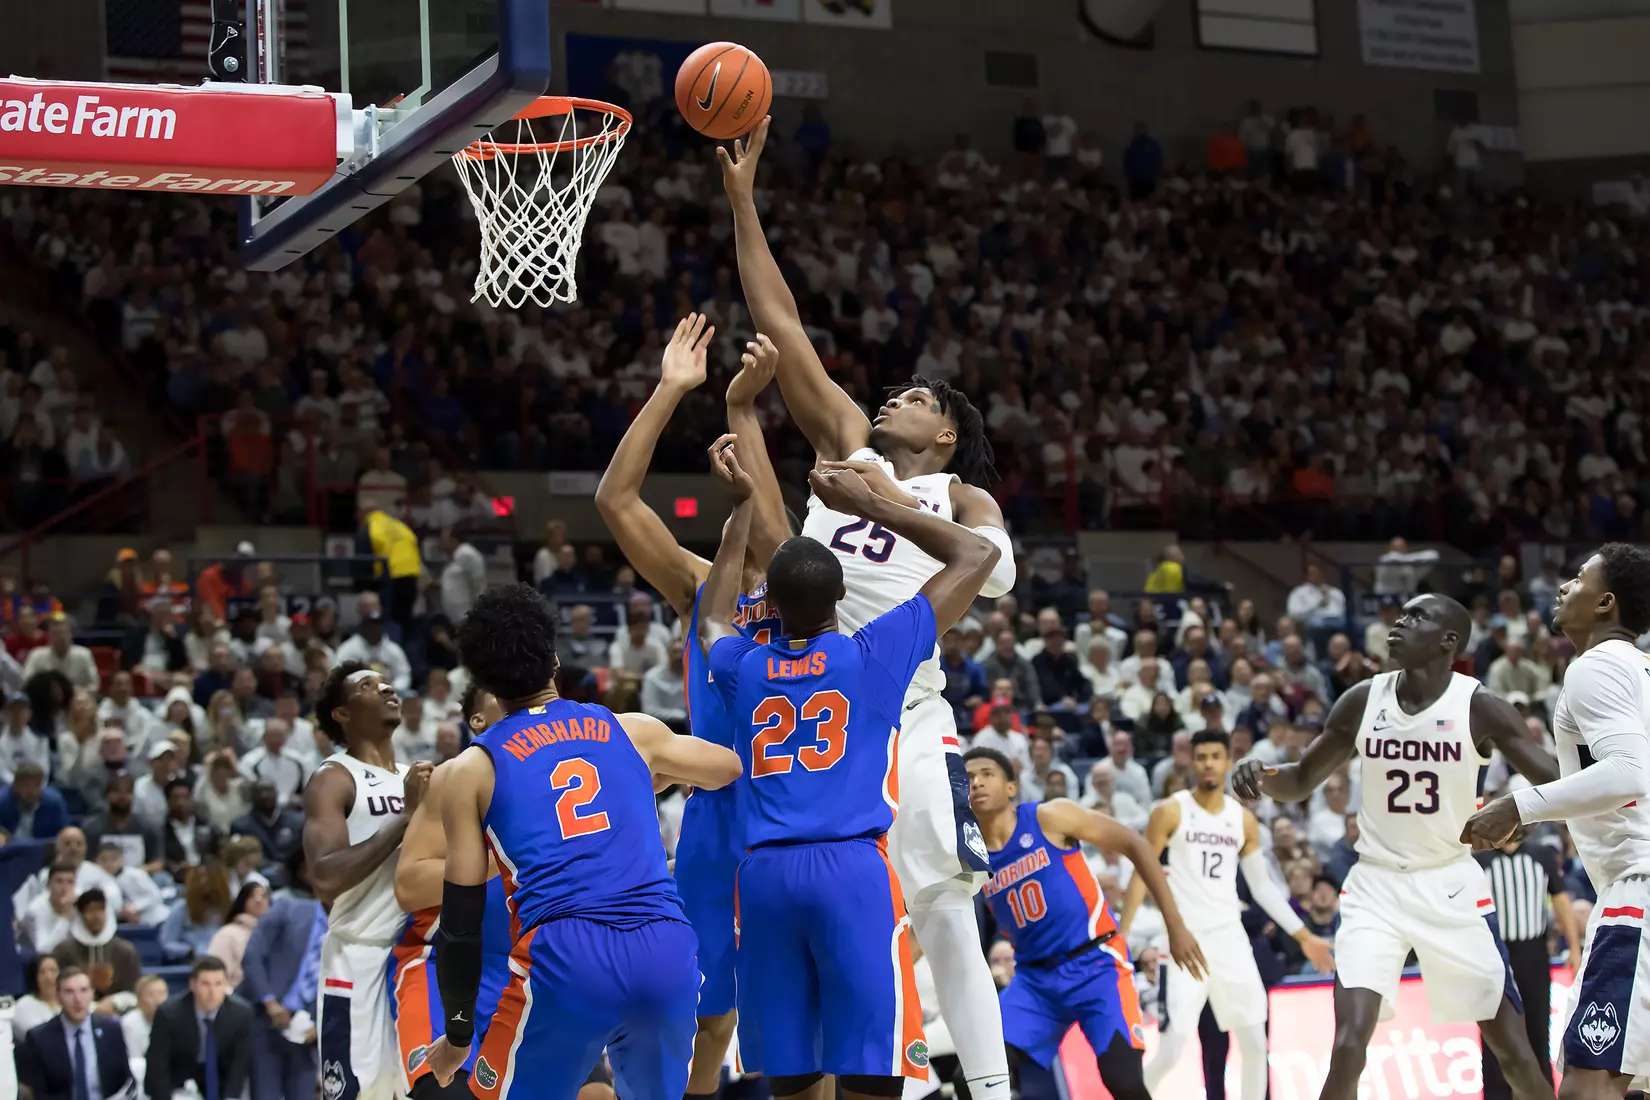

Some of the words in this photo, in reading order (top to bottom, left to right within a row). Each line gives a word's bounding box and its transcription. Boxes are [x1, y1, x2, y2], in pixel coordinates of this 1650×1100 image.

[0, 92, 68, 134] ate
[71, 95, 177, 140] Farm
[732, 89, 754, 120] UCONN
[136, 173, 296, 194] Farm
[829, 516, 897, 564] 25
[767, 651, 827, 681] LEWIS
[501, 717, 611, 763] NEMBHARD
[750, 689, 850, 779] 23
[1365, 737, 1462, 763] UCONN
[549, 756, 612, 841] 2
[1385, 768, 1441, 815] 23
[1185, 830, 1238, 847] UCONN
[982, 846, 1051, 899] FLORIDA
[1202, 850, 1223, 879] 12
[1006, 878, 1048, 929] 10
